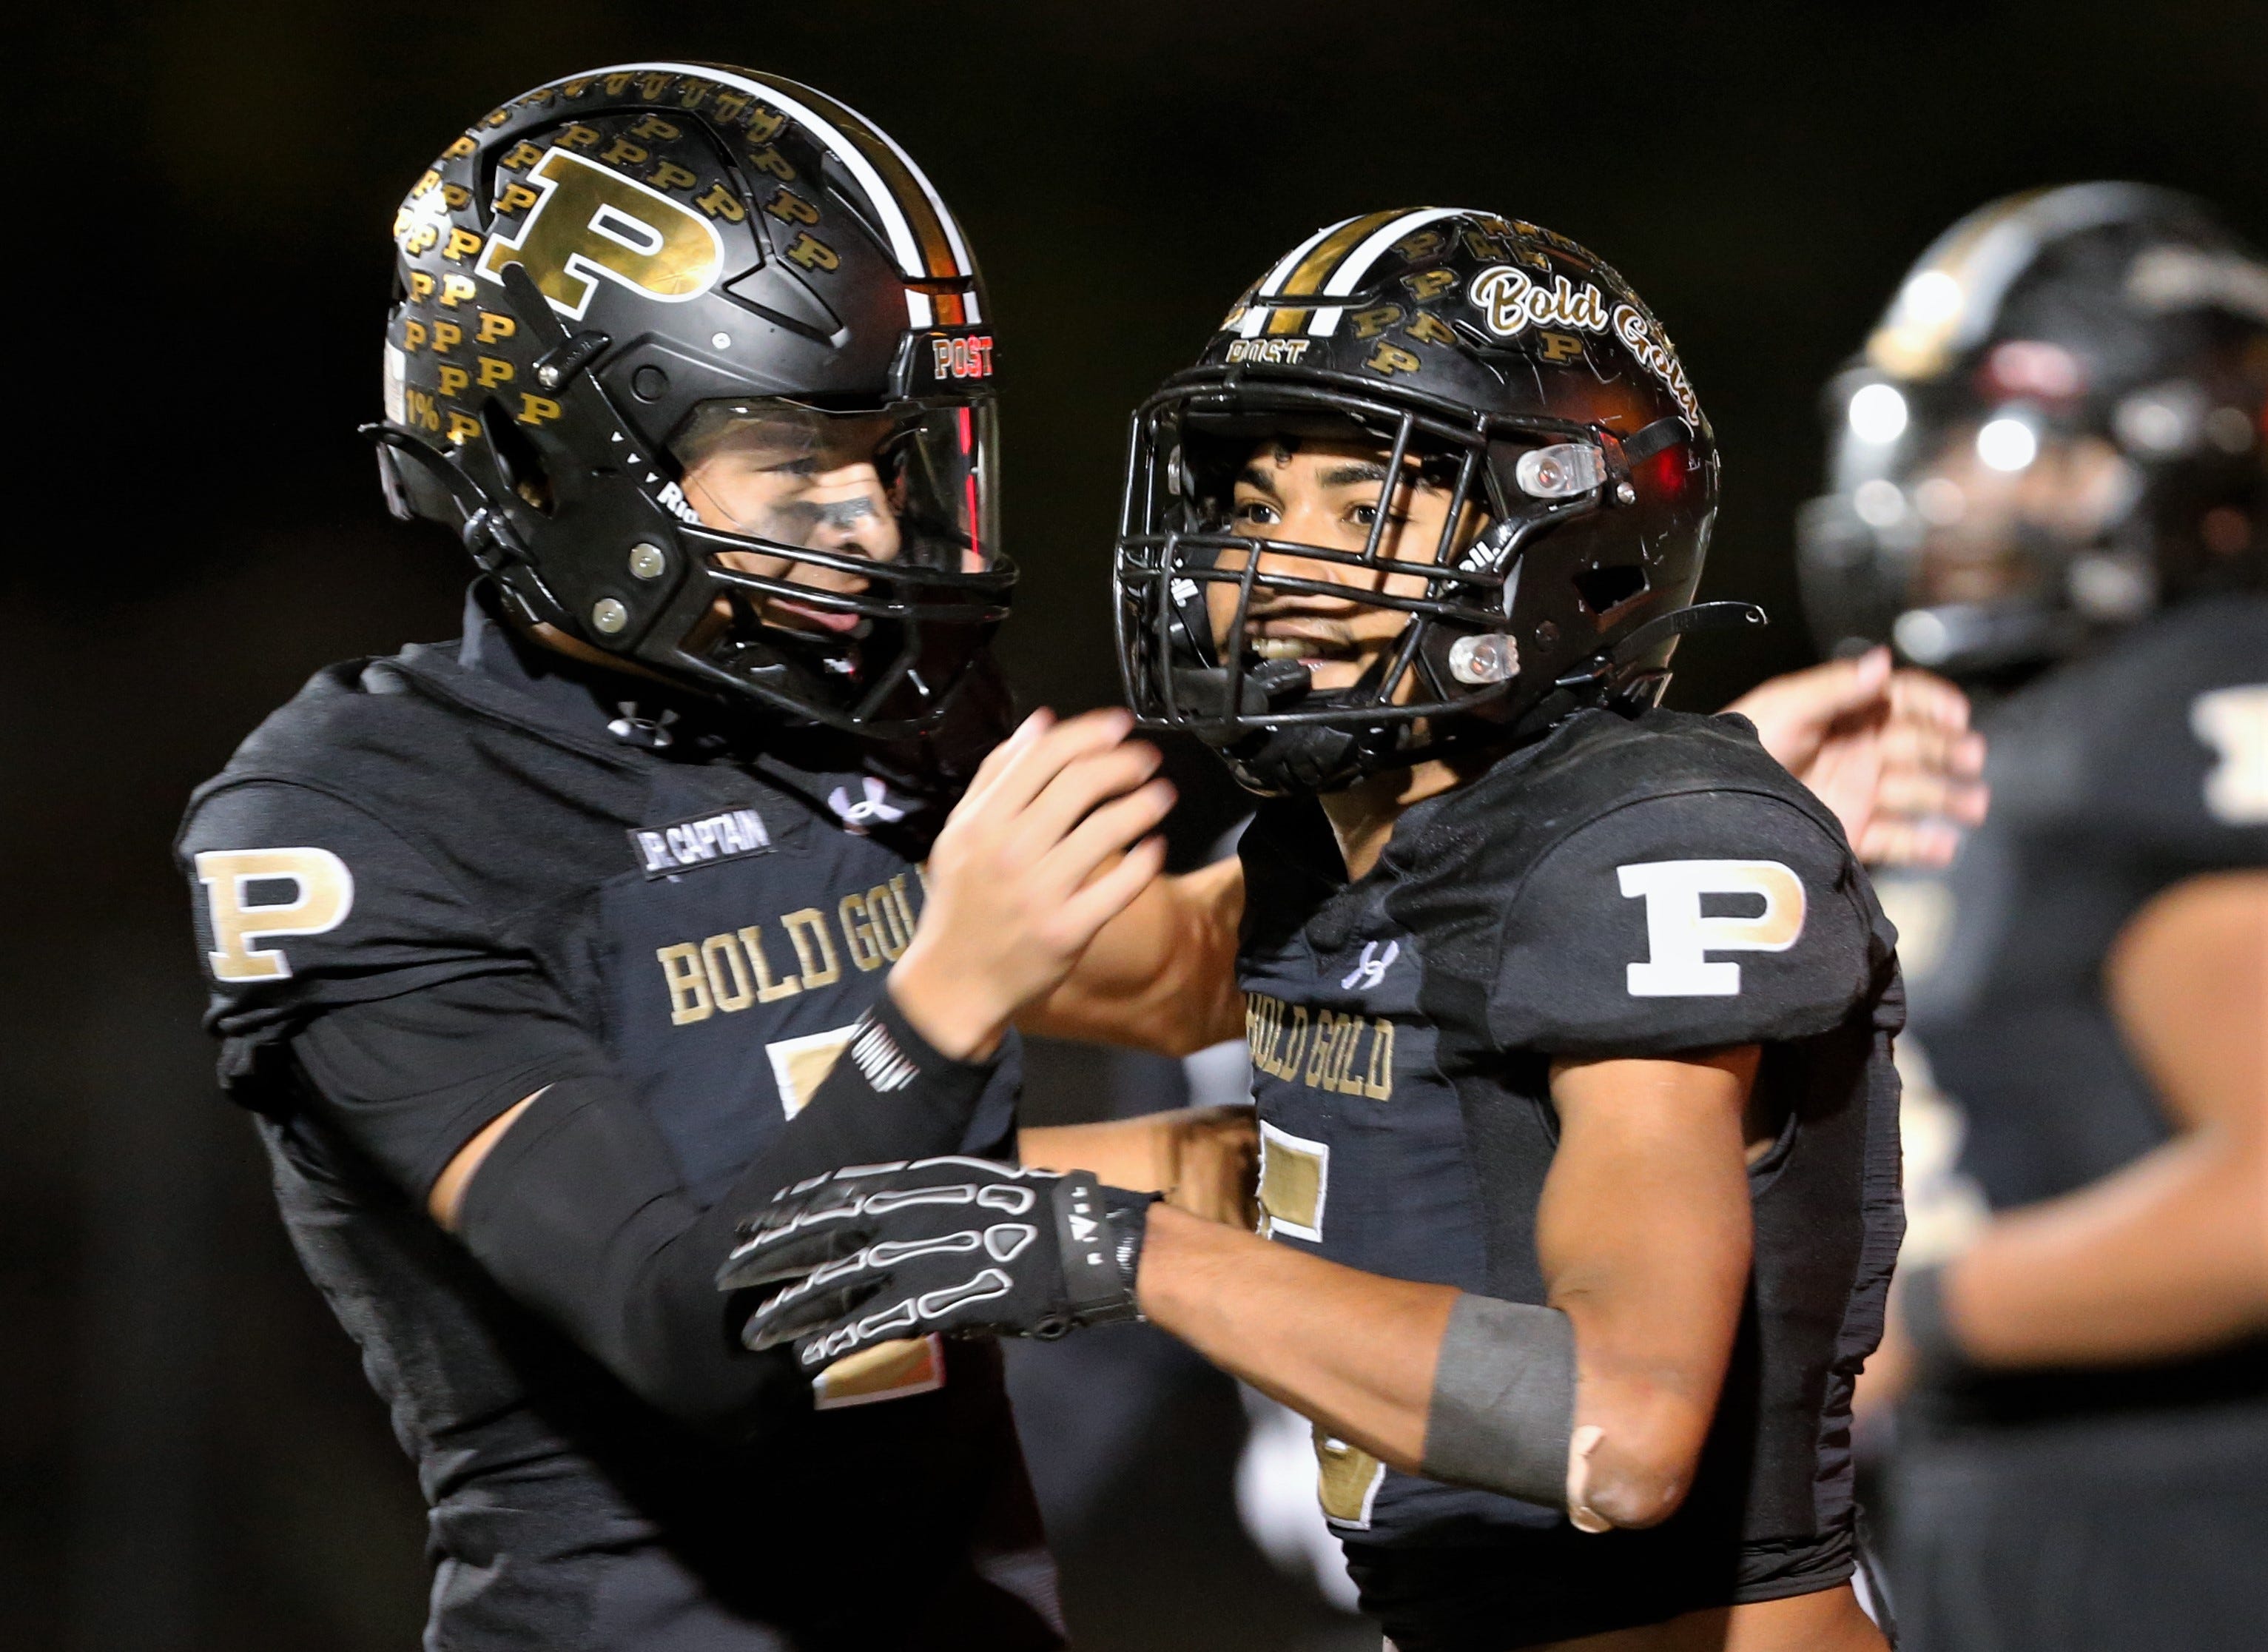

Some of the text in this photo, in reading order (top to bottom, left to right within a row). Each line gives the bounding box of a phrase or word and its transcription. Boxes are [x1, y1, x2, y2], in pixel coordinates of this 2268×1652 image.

[553, 124, 601, 148] P
[631, 115, 680, 141] P
[502, 143, 543, 169] P
[600, 138, 649, 165] P
[647, 161, 697, 189] P
[494, 181, 539, 213] P
[696, 184, 745, 221] P
[767, 188, 820, 224] P
[443, 226, 482, 261] P
[474, 146, 725, 322] P
[787, 232, 840, 270] P
[409, 271, 434, 304] P
[439, 273, 477, 307] P
[1470, 265, 1609, 336] Bold
[403, 320, 428, 352] P
[431, 320, 463, 353] P
[475, 311, 516, 344] P
[932, 336, 993, 380] POST
[1367, 340, 1421, 375] P
[1540, 331, 1584, 361] P
[438, 364, 470, 397] P
[477, 355, 516, 389] P
[519, 392, 562, 426] P
[446, 410, 482, 446] P
[194, 846, 355, 983] P
[1617, 859, 1807, 997] P
[656, 862, 932, 1026] BOLD GOL
[1305, 1007, 1396, 1102] GOLD
